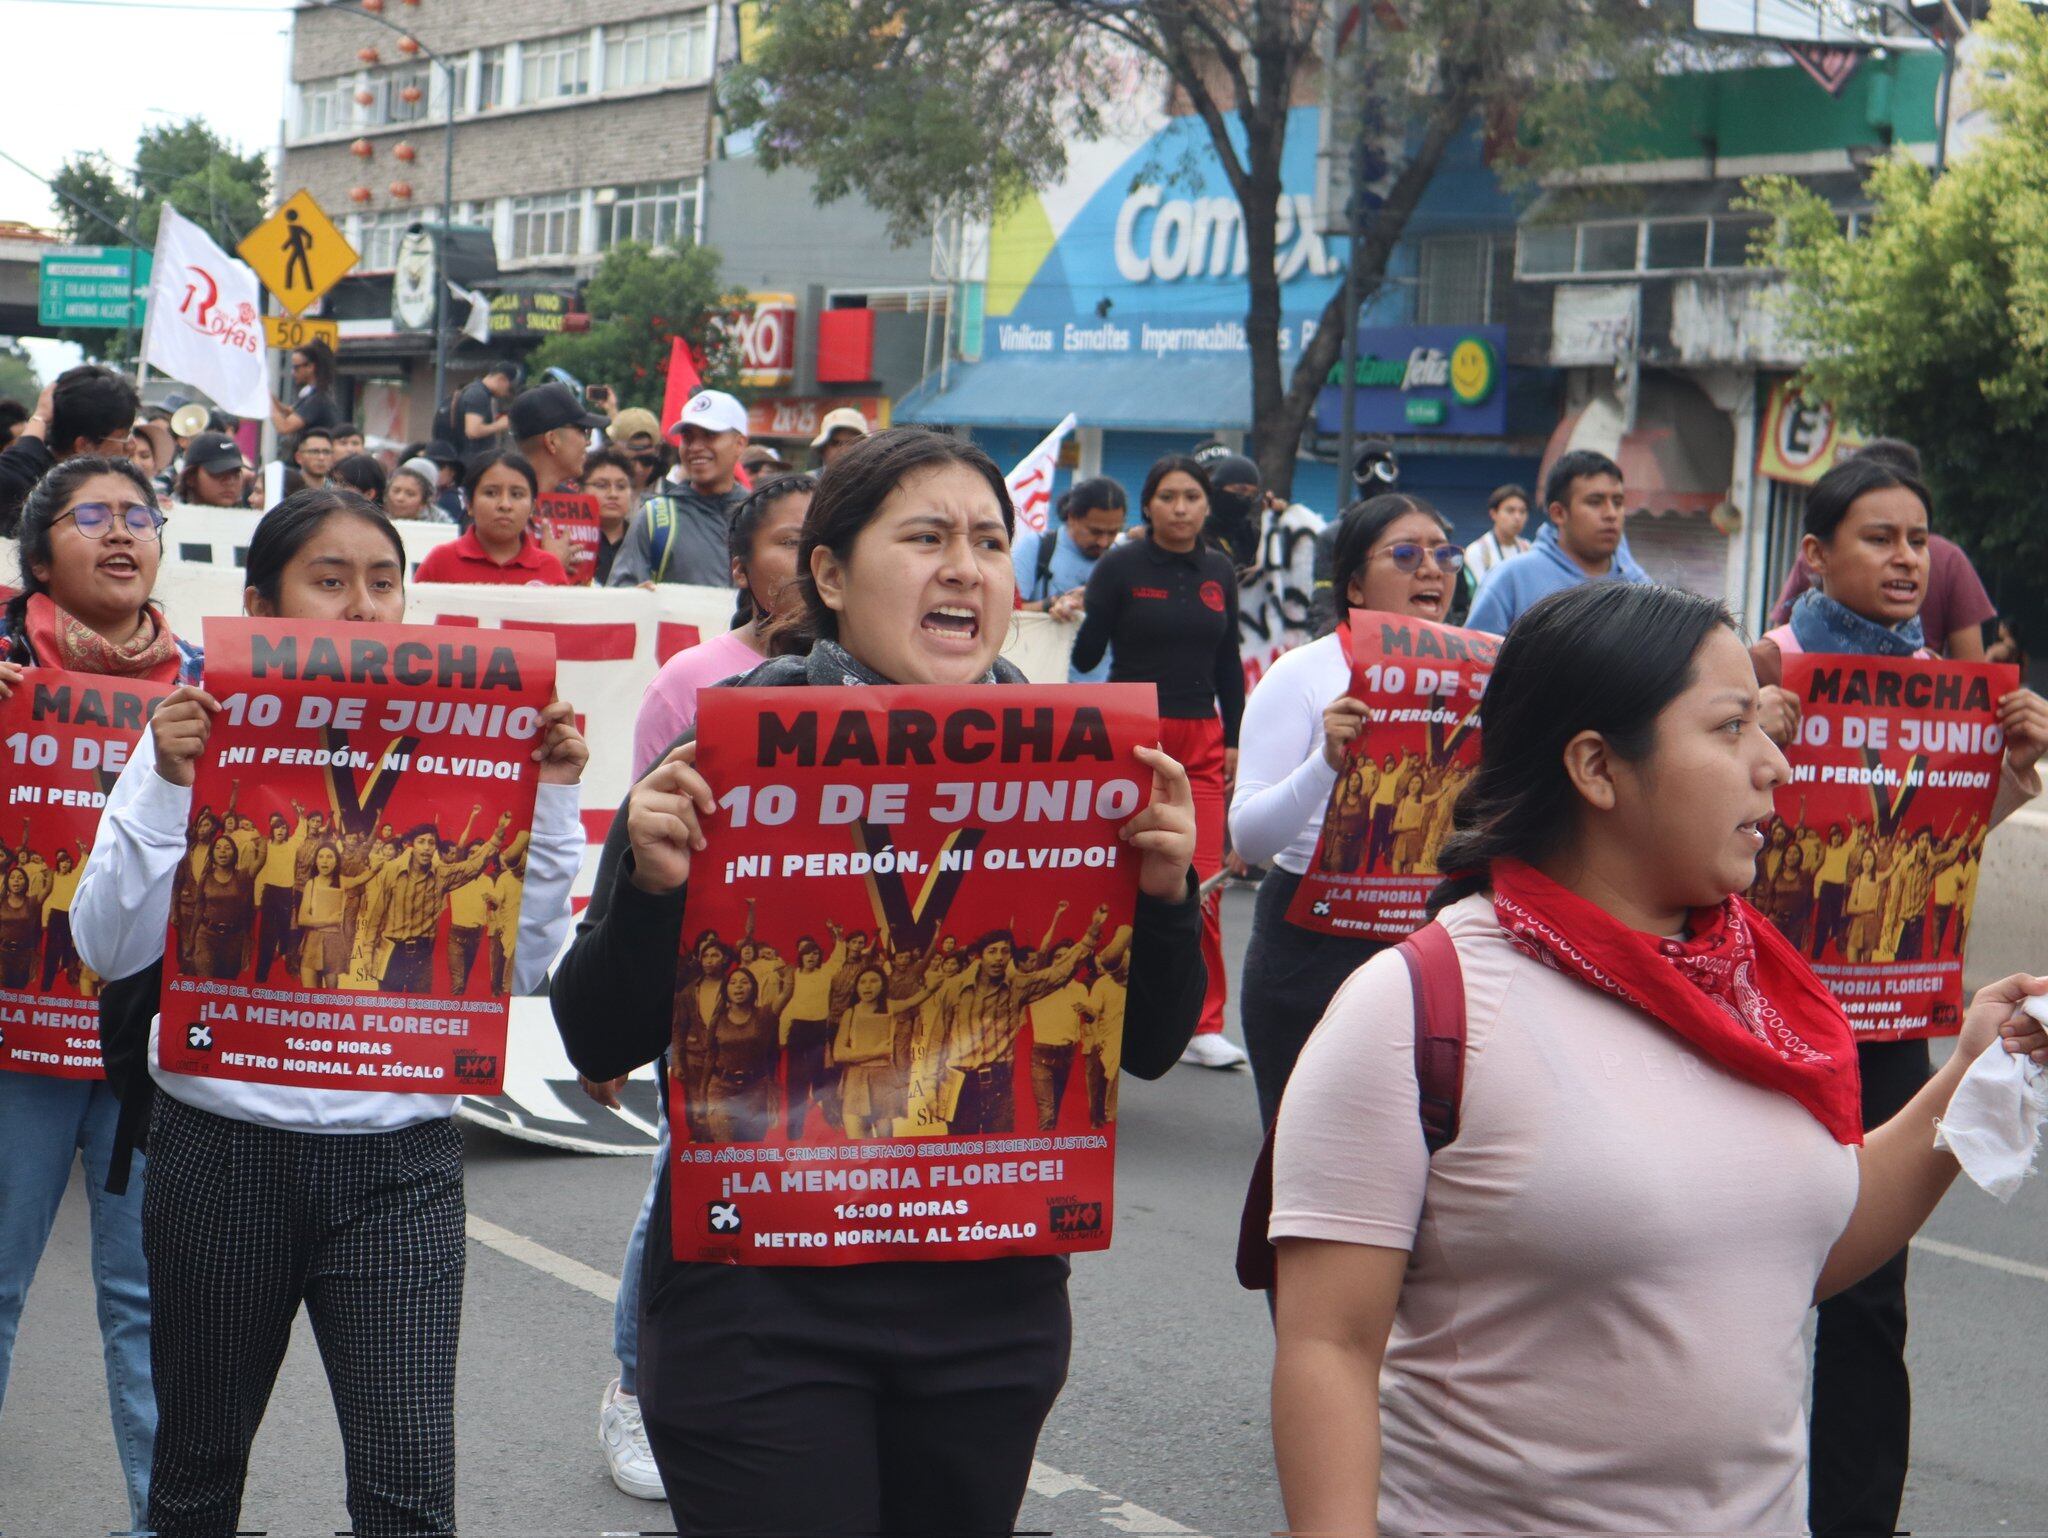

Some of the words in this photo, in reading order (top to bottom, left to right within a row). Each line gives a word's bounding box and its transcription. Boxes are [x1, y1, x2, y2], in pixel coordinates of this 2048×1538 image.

[277, 322, 303, 345] 50
[1063, 323, 1130, 351] Esmaltes
[1381, 623, 1502, 665] MARC
[251, 634, 523, 692] MARCHA
[1364, 664, 1406, 694] 10
[1414, 667, 1460, 697] DE
[1808, 667, 1992, 713] MARCHA
[220, 692, 283, 727] 10
[295, 695, 368, 730] DE
[379, 699, 540, 740] JUNIO
[1388, 706, 1460, 726] PERDÓN,
[757, 706, 1114, 768] MARCHA
[1842, 716, 1889, 750] DE
[1898, 719, 2005, 755] JUNIO
[5, 732, 58, 766] 10
[71, 737, 129, 773] DE
[218, 746, 255, 768] ¡NI
[261, 745, 376, 771] PERDÓN,
[381, 753, 409, 772] NI
[416, 755, 521, 781] OLVIDO!
[1821, 763, 1902, 788] PERDÓN,
[1905, 769, 1924, 787] NI
[1927, 770, 1991, 790] OLVIDO!
[9, 785, 42, 805] ¡NI
[47, 788, 110, 809] PERD
[718, 784, 798, 828] 10
[818, 782, 910, 825] DE
[929, 778, 1140, 823] JUNIO
[724, 854, 771, 884] ¡NI
[782, 845, 928, 878] PERDÓN,
[938, 849, 973, 872] NI
[988, 846, 1118, 870] OLVIDO!
[1324, 887, 1352, 901] ¡LA
[1356, 889, 1422, 904] MEMORIA
[1331, 918, 1371, 931] METRO
[1378, 909, 1406, 919] 16:00
[170, 980, 180, 992] A
[196, 980, 229, 995] AÑOS
[229, 986, 251, 998] DEL
[252, 988, 293, 1003] CRIMEN
[294, 992, 311, 1004] DE
[311, 993, 353, 1006] ESTADO
[354, 995, 406, 1009] SEGUIMOS
[407, 1000, 460, 1012] EXIGIENDO
[460, 1001, 503, 1013] JUSTICIA
[1884, 977, 1944, 996] FLORECE!
[200, 1001, 239, 1022] ¡LA
[245, 1005, 356, 1031] MEMORIA
[362, 1014, 469, 1036] FLORECE!
[1841, 1001, 1865, 1014] 6:00
[1867, 1000, 1902, 1014] HORAS
[1877, 1018, 1891, 1030] AL
[1892, 1014, 1928, 1030] ZÓCALO
[11, 1048, 59, 1065] METRO
[63, 1055, 104, 1068] NORM
[285, 1037, 333, 1052] 16:00
[337, 1041, 392, 1055] HORAS
[220, 1051, 279, 1070] METRO
[282, 1058, 352, 1075] NORMAL
[356, 1063, 377, 1076] AL
[381, 1062, 444, 1079] ZÓCALO
[680, 1150, 692, 1162] A
[694, 1149, 712, 1162] 53
[713, 1146, 755, 1164] AÑOS
[757, 1148, 784, 1162] DEL
[785, 1146, 838, 1162] CRIMEN
[839, 1145, 860, 1159] DE
[860, 1143, 916, 1159] ESTADO
[917, 1141, 984, 1157] SEGUIMOS
[985, 1137, 1051, 1154] EXIGIENDO
[1052, 1135, 1108, 1151] JUSTICIA
[722, 1171, 772, 1198] ¡LA
[780, 1165, 921, 1193] MEMORIA
[929, 1159, 1064, 1188] FLORECE!
[833, 1202, 893, 1220] 16:00
[898, 1199, 969, 1218] HORAS
[754, 1231, 828, 1248] METRO
[833, 1228, 920, 1247] NORMAL
[924, 1226, 952, 1244] AL
[957, 1220, 1037, 1241] ZÓCALO
